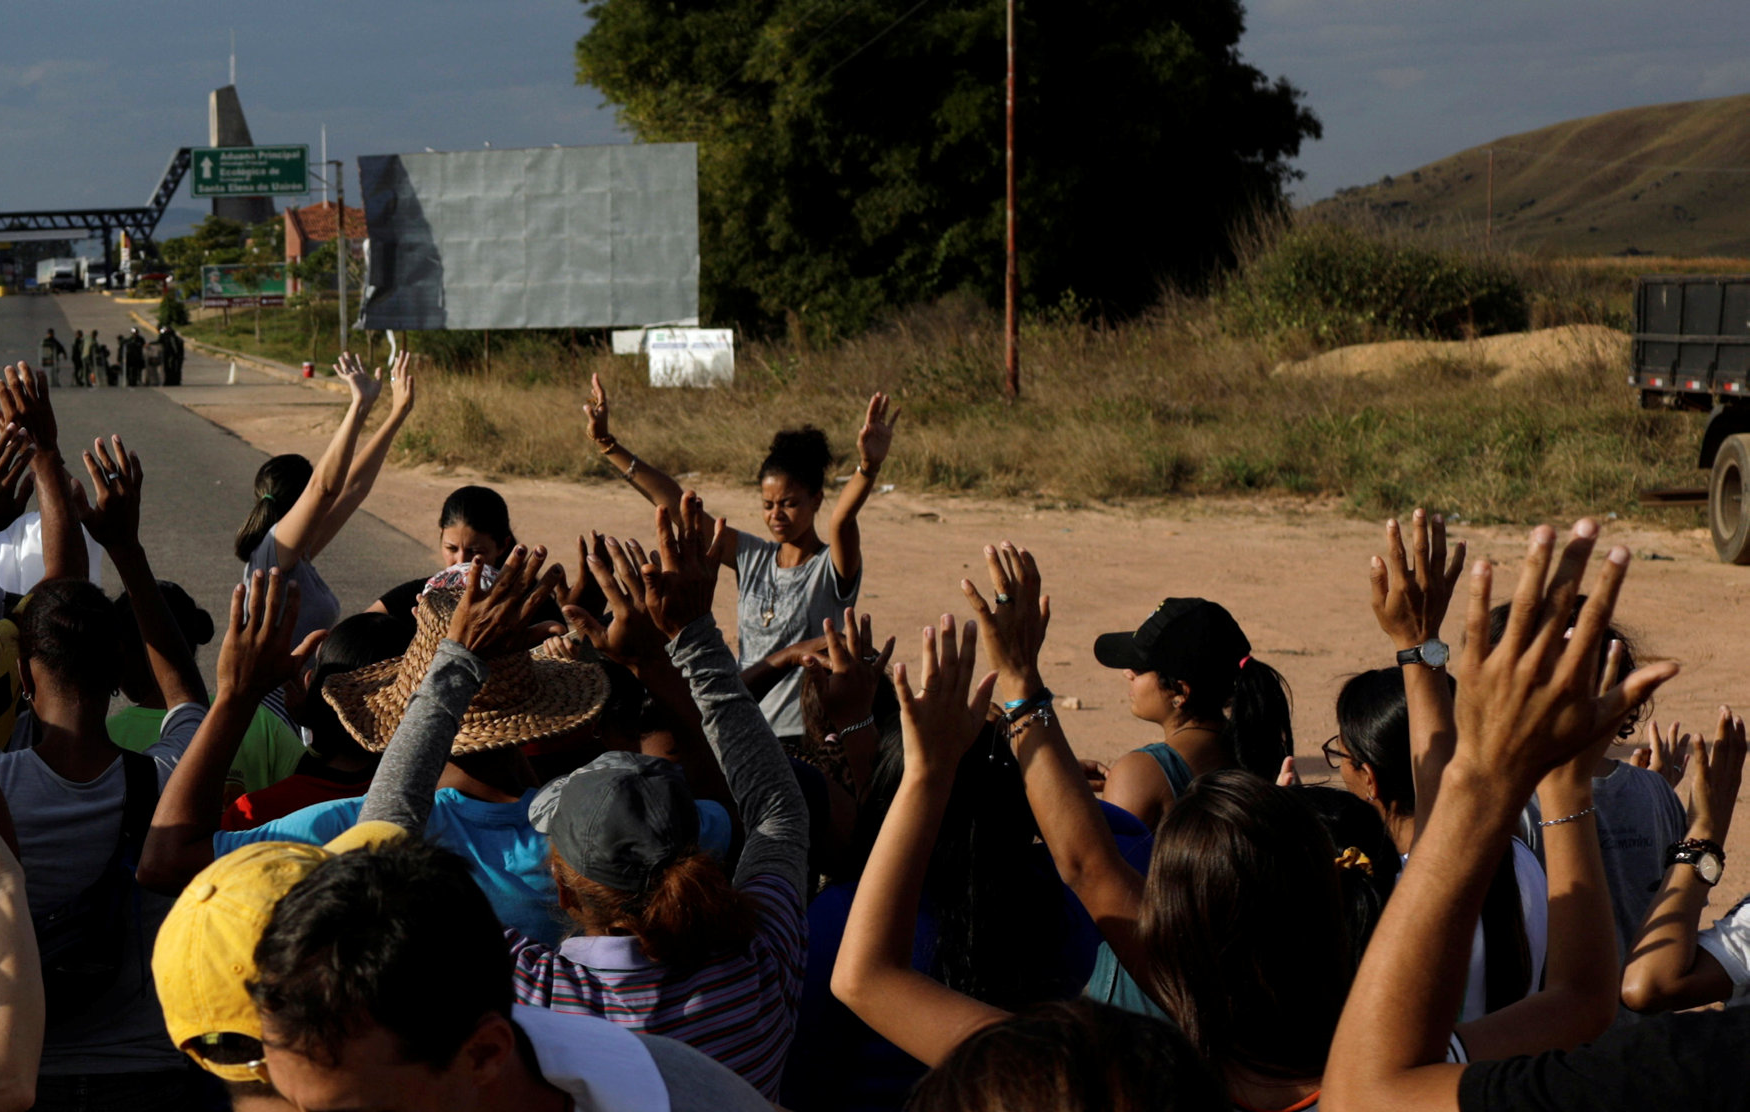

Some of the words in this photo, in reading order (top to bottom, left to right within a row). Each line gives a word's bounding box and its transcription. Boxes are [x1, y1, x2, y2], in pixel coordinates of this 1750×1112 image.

[258, 150, 300, 161] Principal
[198, 184, 226, 192] Santa
[228, 183, 255, 192] Elena
